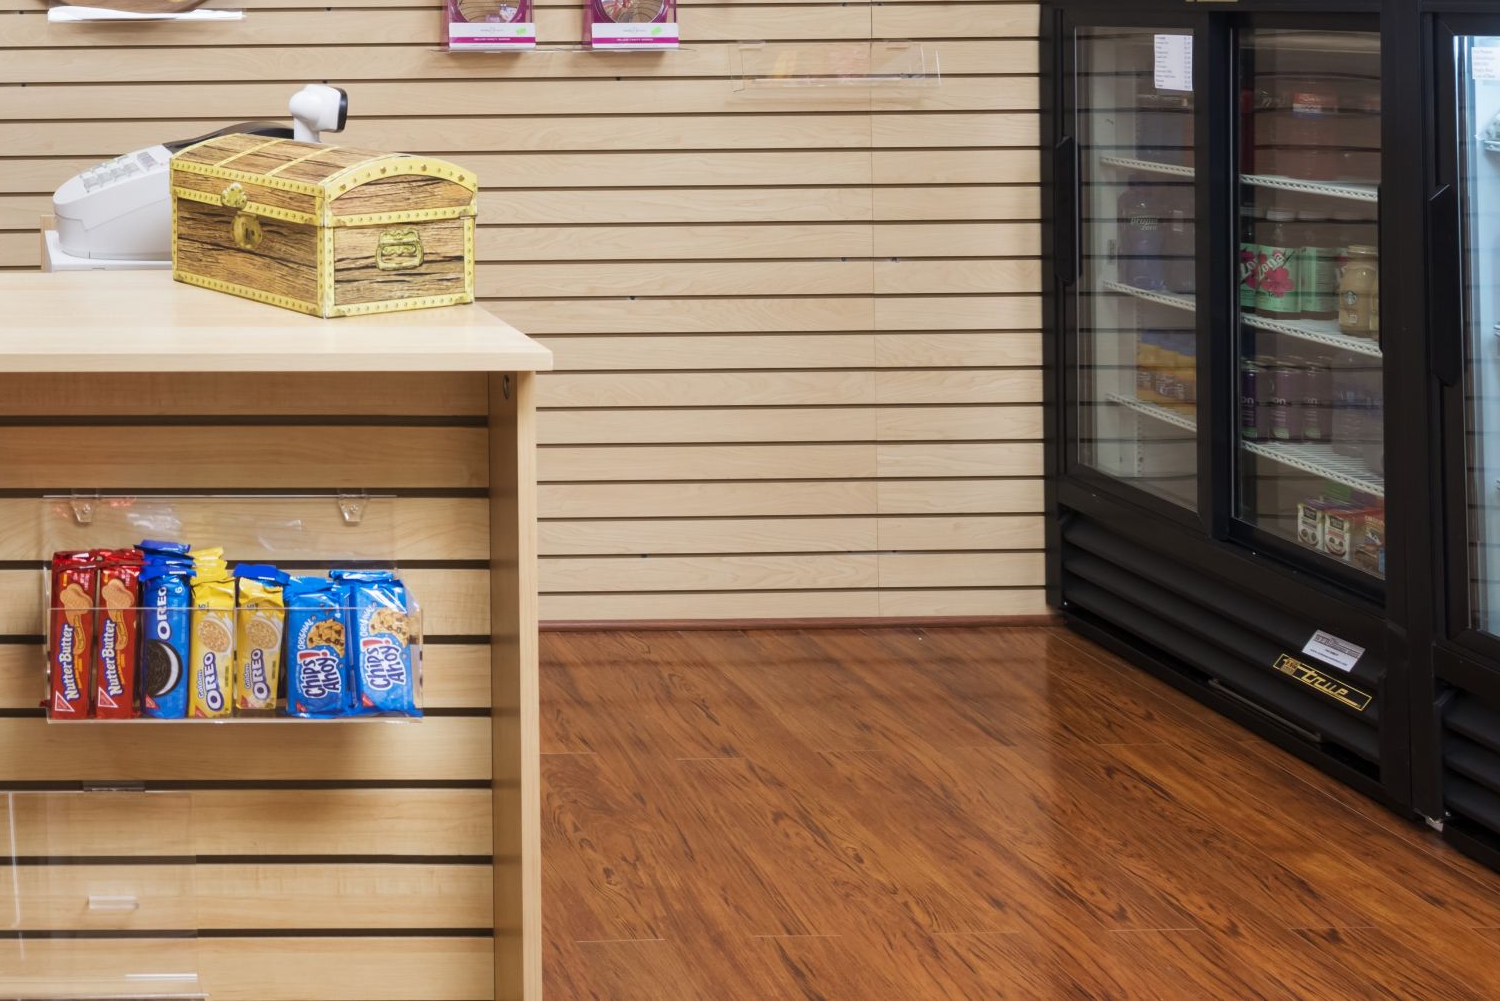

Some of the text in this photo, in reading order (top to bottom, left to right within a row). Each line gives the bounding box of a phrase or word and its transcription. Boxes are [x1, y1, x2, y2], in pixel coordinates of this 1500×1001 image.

[157, 586, 171, 640] OREO
[204, 652, 224, 711] OREO
[251, 649, 271, 700] OREO
[299, 657, 327, 699] Chips
[365, 647, 392, 691] Chips
